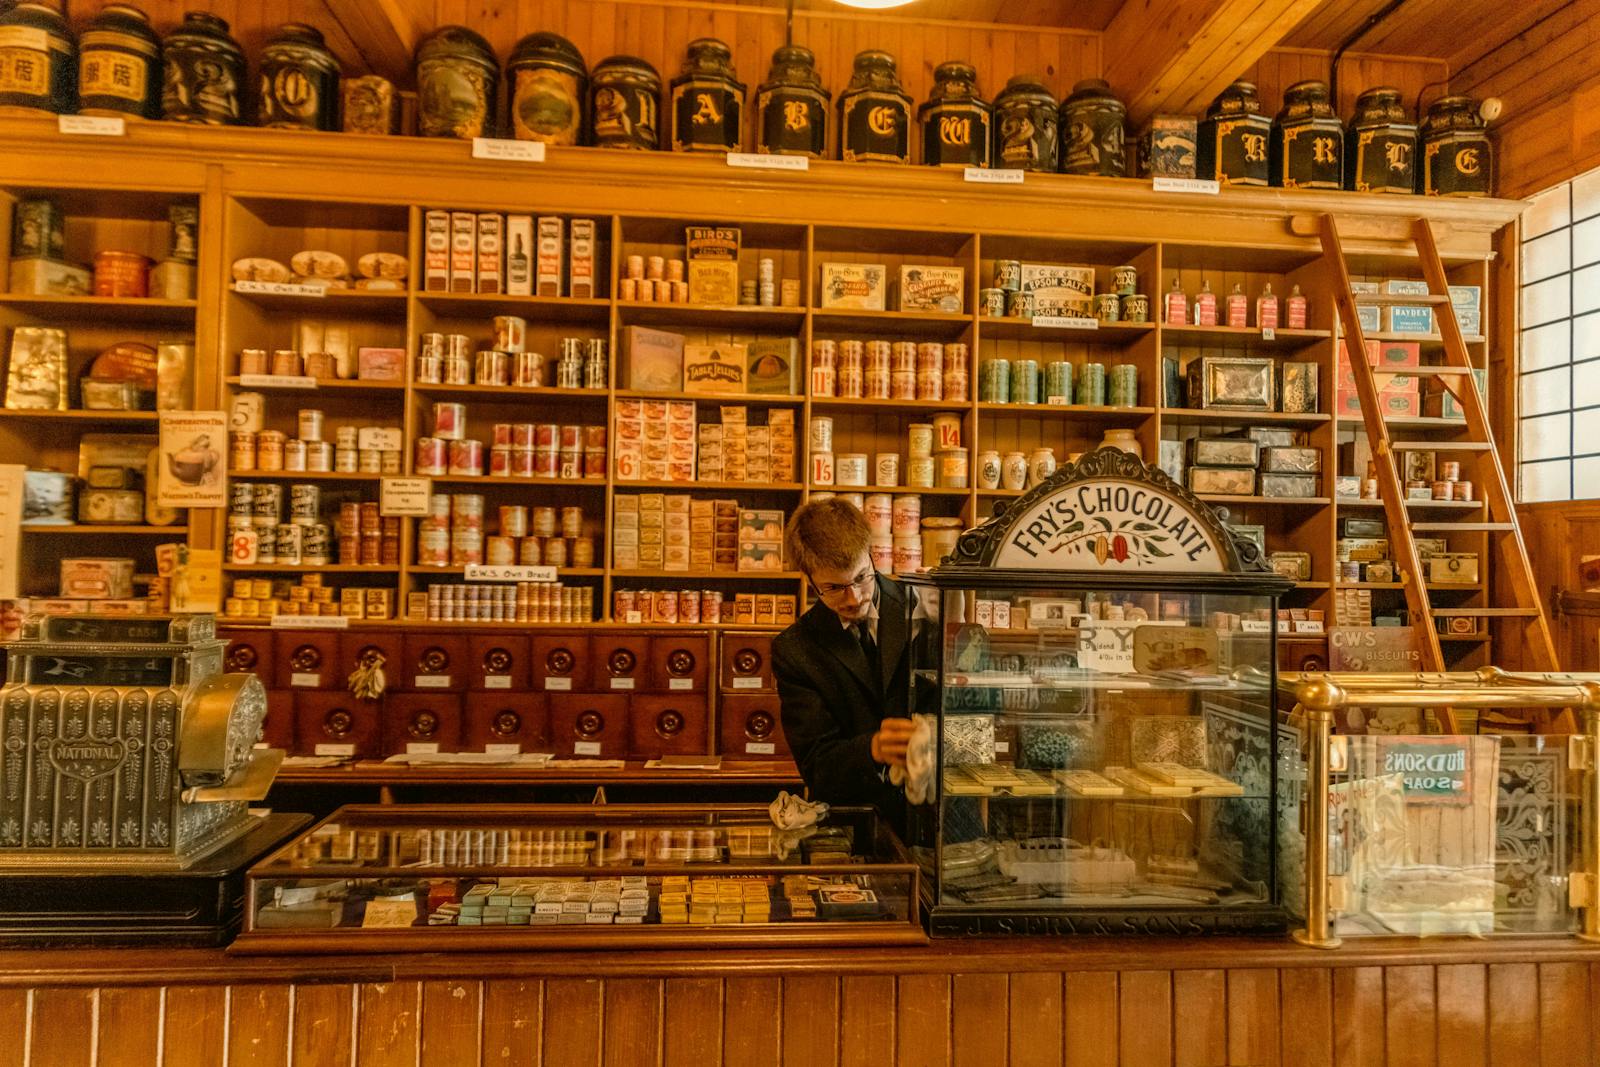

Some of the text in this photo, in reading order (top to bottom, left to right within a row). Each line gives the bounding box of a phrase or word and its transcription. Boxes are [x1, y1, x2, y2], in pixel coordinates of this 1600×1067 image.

[691, 93, 722, 124] A
[694, 229, 734, 239] BIRD'S
[1030, 276, 1088, 293] EPSOM SALTS
[1035, 307, 1058, 317] PSOM
[690, 365, 713, 379] TABLE
[232, 402, 249, 427] 5
[620, 454, 632, 476] 6
[1012, 486, 1212, 562] FRY'S CHOCOLATE
[235, 536, 250, 559] 8
[504, 570, 522, 578] Own
[527, 570, 551, 579] Brand
[1331, 631, 1377, 648] CWS
[1366, 650, 1420, 661] BISCUITS
[57, 746, 119, 761] NATIONAL
